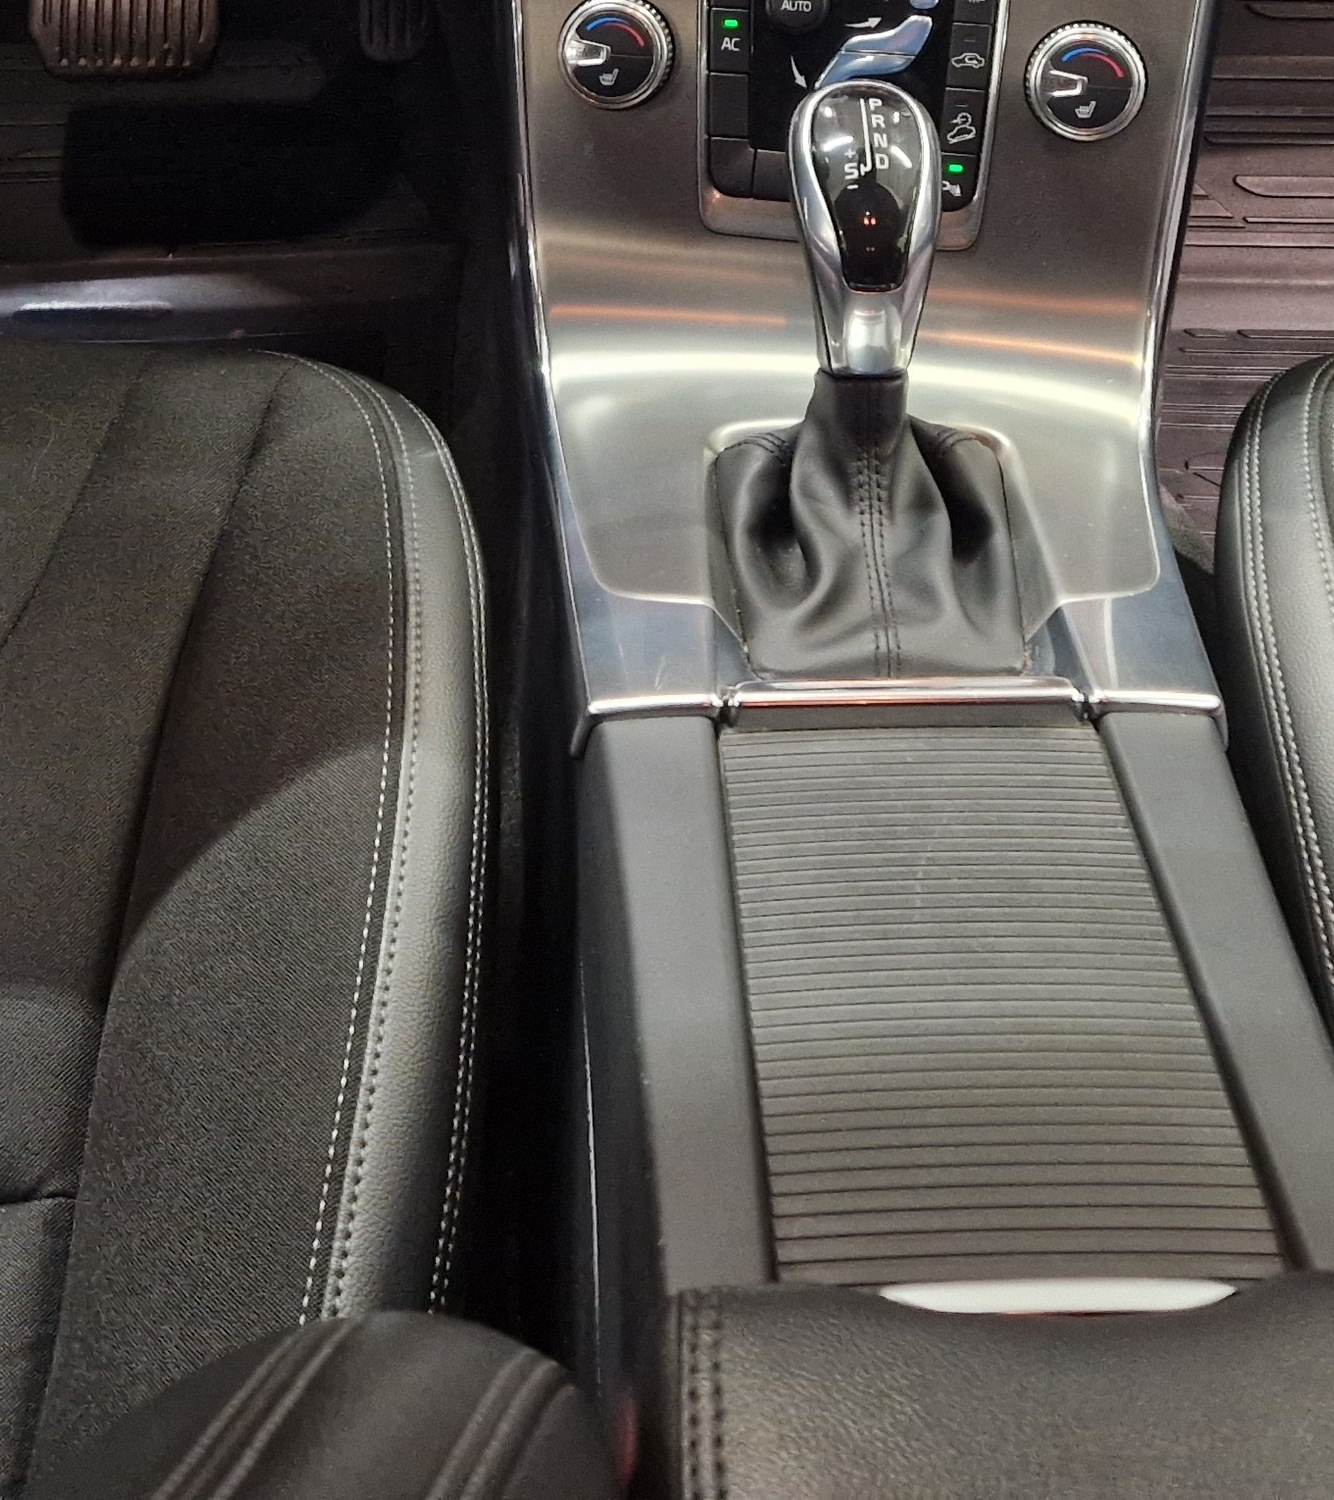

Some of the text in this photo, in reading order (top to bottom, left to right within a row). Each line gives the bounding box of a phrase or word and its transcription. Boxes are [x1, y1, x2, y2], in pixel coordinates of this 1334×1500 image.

[781, 0, 811, 12] AUTO
[721, 38, 740, 52] AC
[869, 98, 882, 111] P
[871, 114, 885, 129] R
[874, 132, 888, 148] N
[876, 153, 889, 170] D
[844, 164, 859, 180] S
